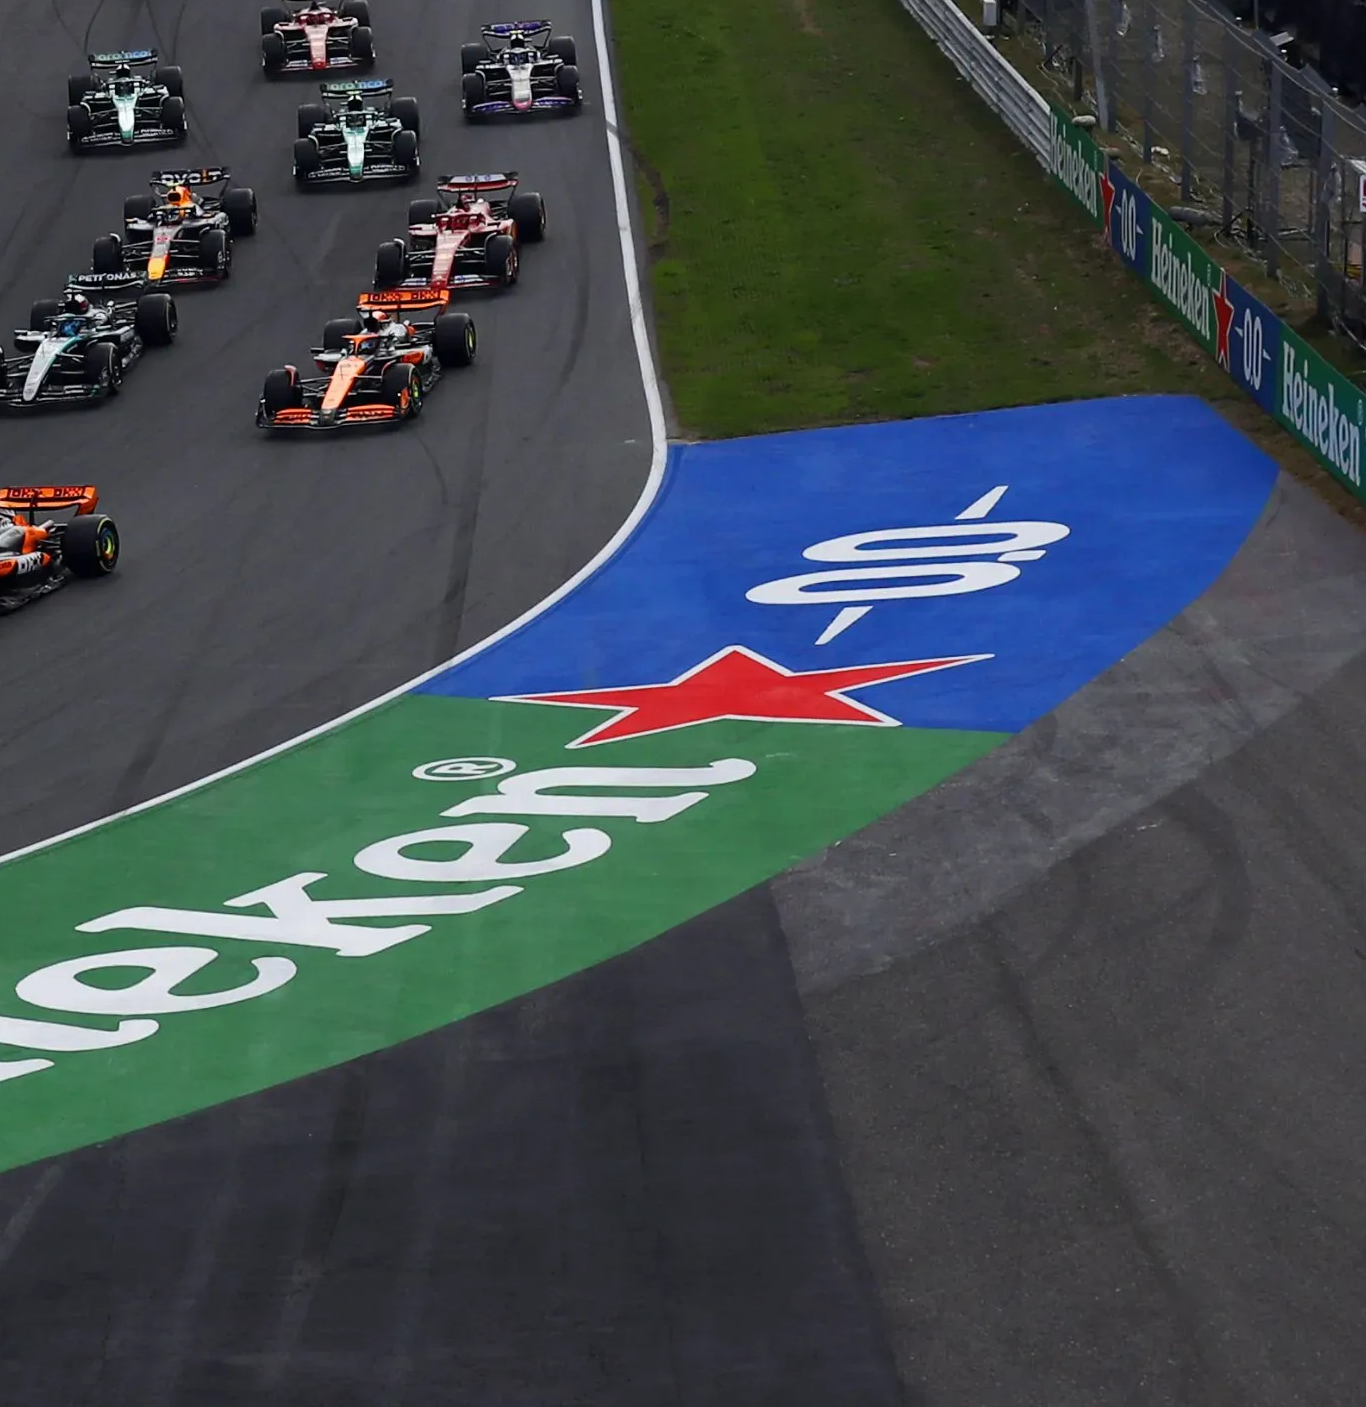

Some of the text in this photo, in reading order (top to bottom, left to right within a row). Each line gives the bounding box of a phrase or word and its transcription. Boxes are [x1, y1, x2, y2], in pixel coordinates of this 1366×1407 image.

[78, 271, 138, 283] PETRONAS
[1049, 113, 1098, 218] Heineken
[1151, 219, 1210, 340] Heineken
[1242, 307, 1262, 391] 0.0
[1282, 341, 1361, 486] Heineken
